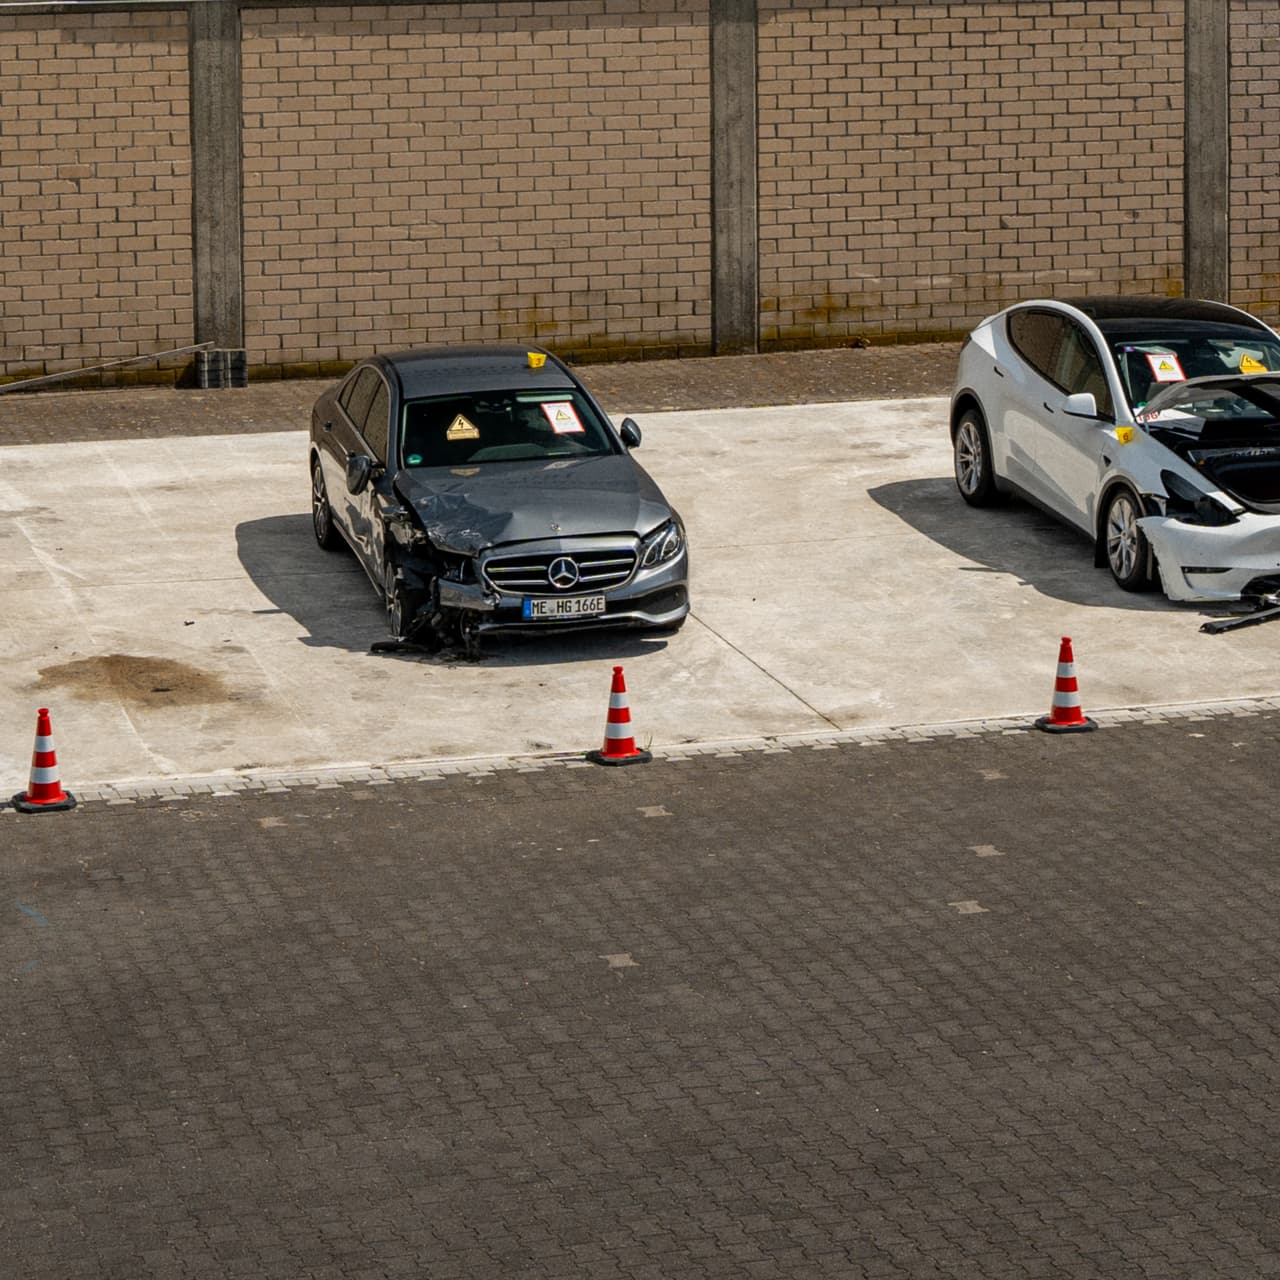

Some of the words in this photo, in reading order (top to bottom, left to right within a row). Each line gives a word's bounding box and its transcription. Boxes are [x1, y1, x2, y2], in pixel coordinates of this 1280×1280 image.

[1122, 433, 1129, 441] 6
[531, 601, 548, 615] ME
[556, 600, 572, 614] HG
[575, 597, 604, 613] 166E
